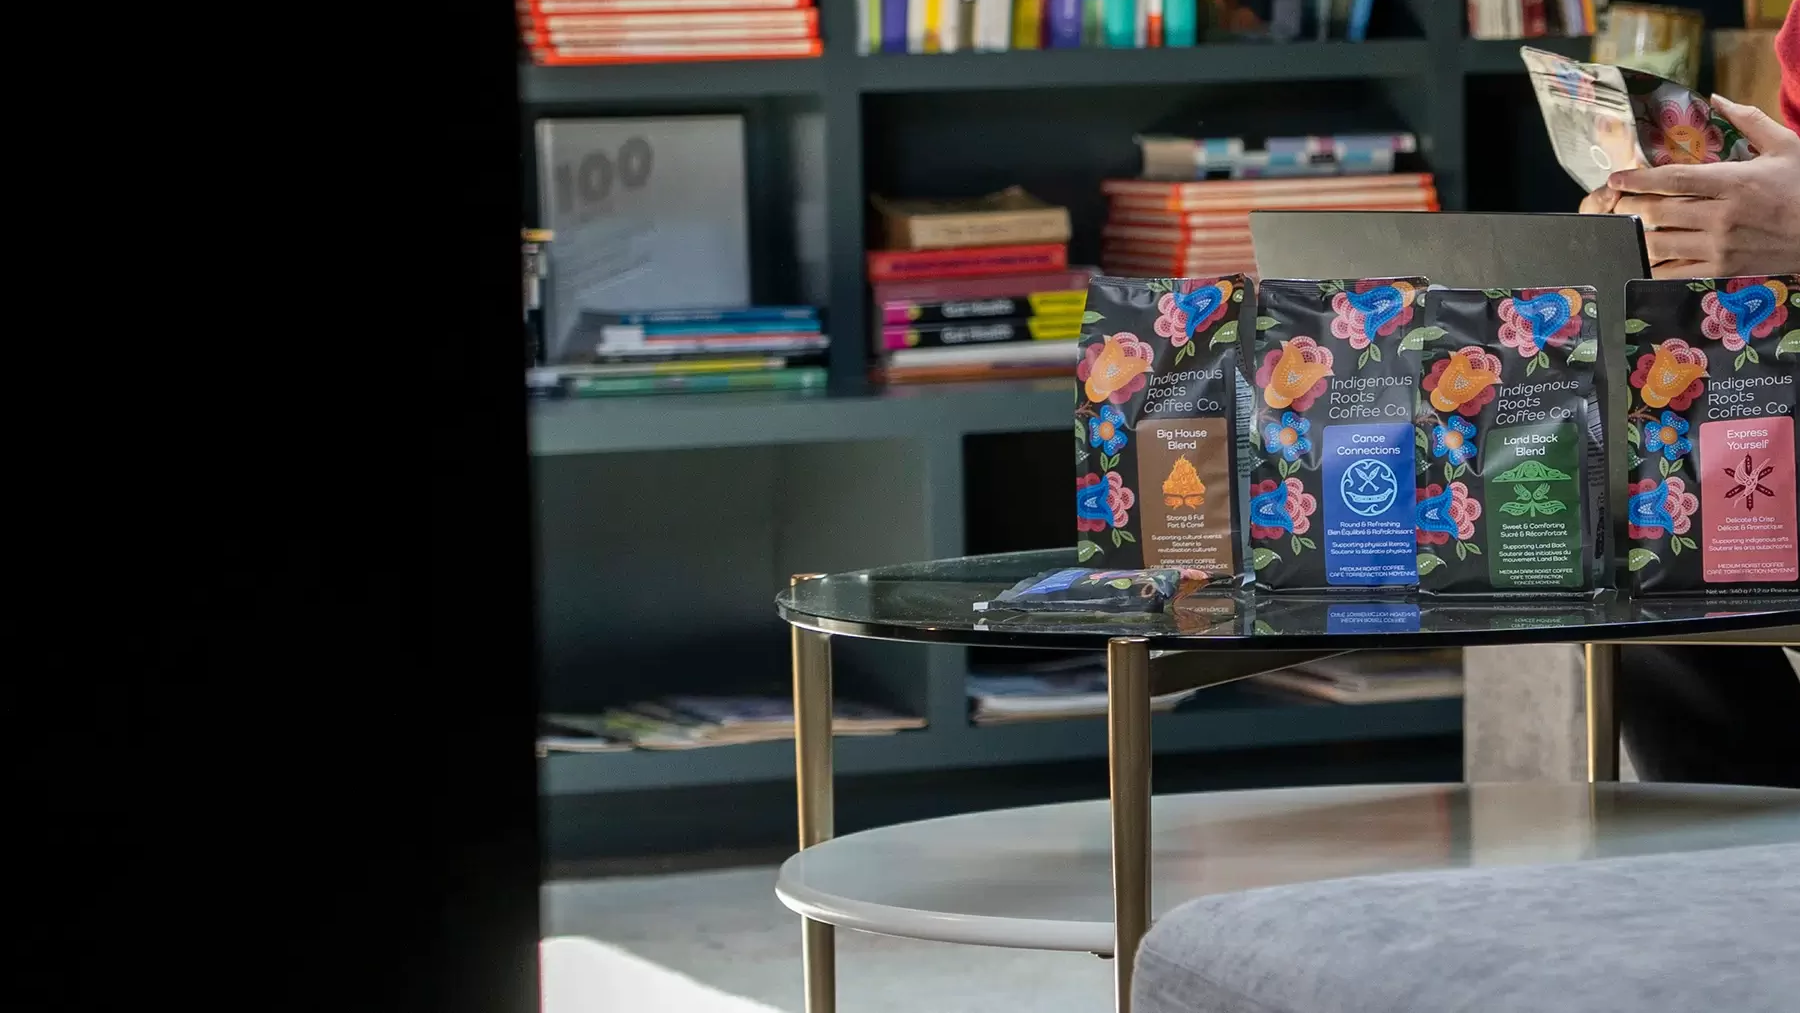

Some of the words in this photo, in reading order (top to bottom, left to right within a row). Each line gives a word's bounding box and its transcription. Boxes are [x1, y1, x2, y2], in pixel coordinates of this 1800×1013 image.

[554, 136, 655, 213] 100
[1149, 369, 1223, 387] Indigenous
[1332, 376, 1413, 391] Indigenous
[1708, 376, 1793, 392] Indigenous
[1147, 386, 1186, 400] Roots
[1500, 381, 1579, 397] Indigenous
[1331, 392, 1375, 404] Roots
[1498, 397, 1541, 412] Roots
[1709, 392, 1755, 406] Roots
[1144, 399, 1193, 413] Coffee
[1197, 398, 1222, 411] Co.
[1329, 405, 1381, 419] Coffee
[1385, 404, 1409, 416] Co.
[1708, 404, 1762, 419] Coffee
[1766, 402, 1791, 414] Co.
[1496, 410, 1546, 425] Coffee
[1550, 407, 1574, 419] Co.
[1157, 430, 1173, 440] Big
[1175, 429, 1207, 438] House
[1352, 434, 1386, 443] Canoe
[1504, 435, 1530, 445] Land
[1532, 434, 1558, 444] Back
[1727, 429, 1768, 439] Express
[1168, 441, 1197, 450] Blend
[1337, 446, 1401, 455] Connections
[1516, 446, 1545, 457] Blend
[1727, 440, 1769, 450] Yourself
